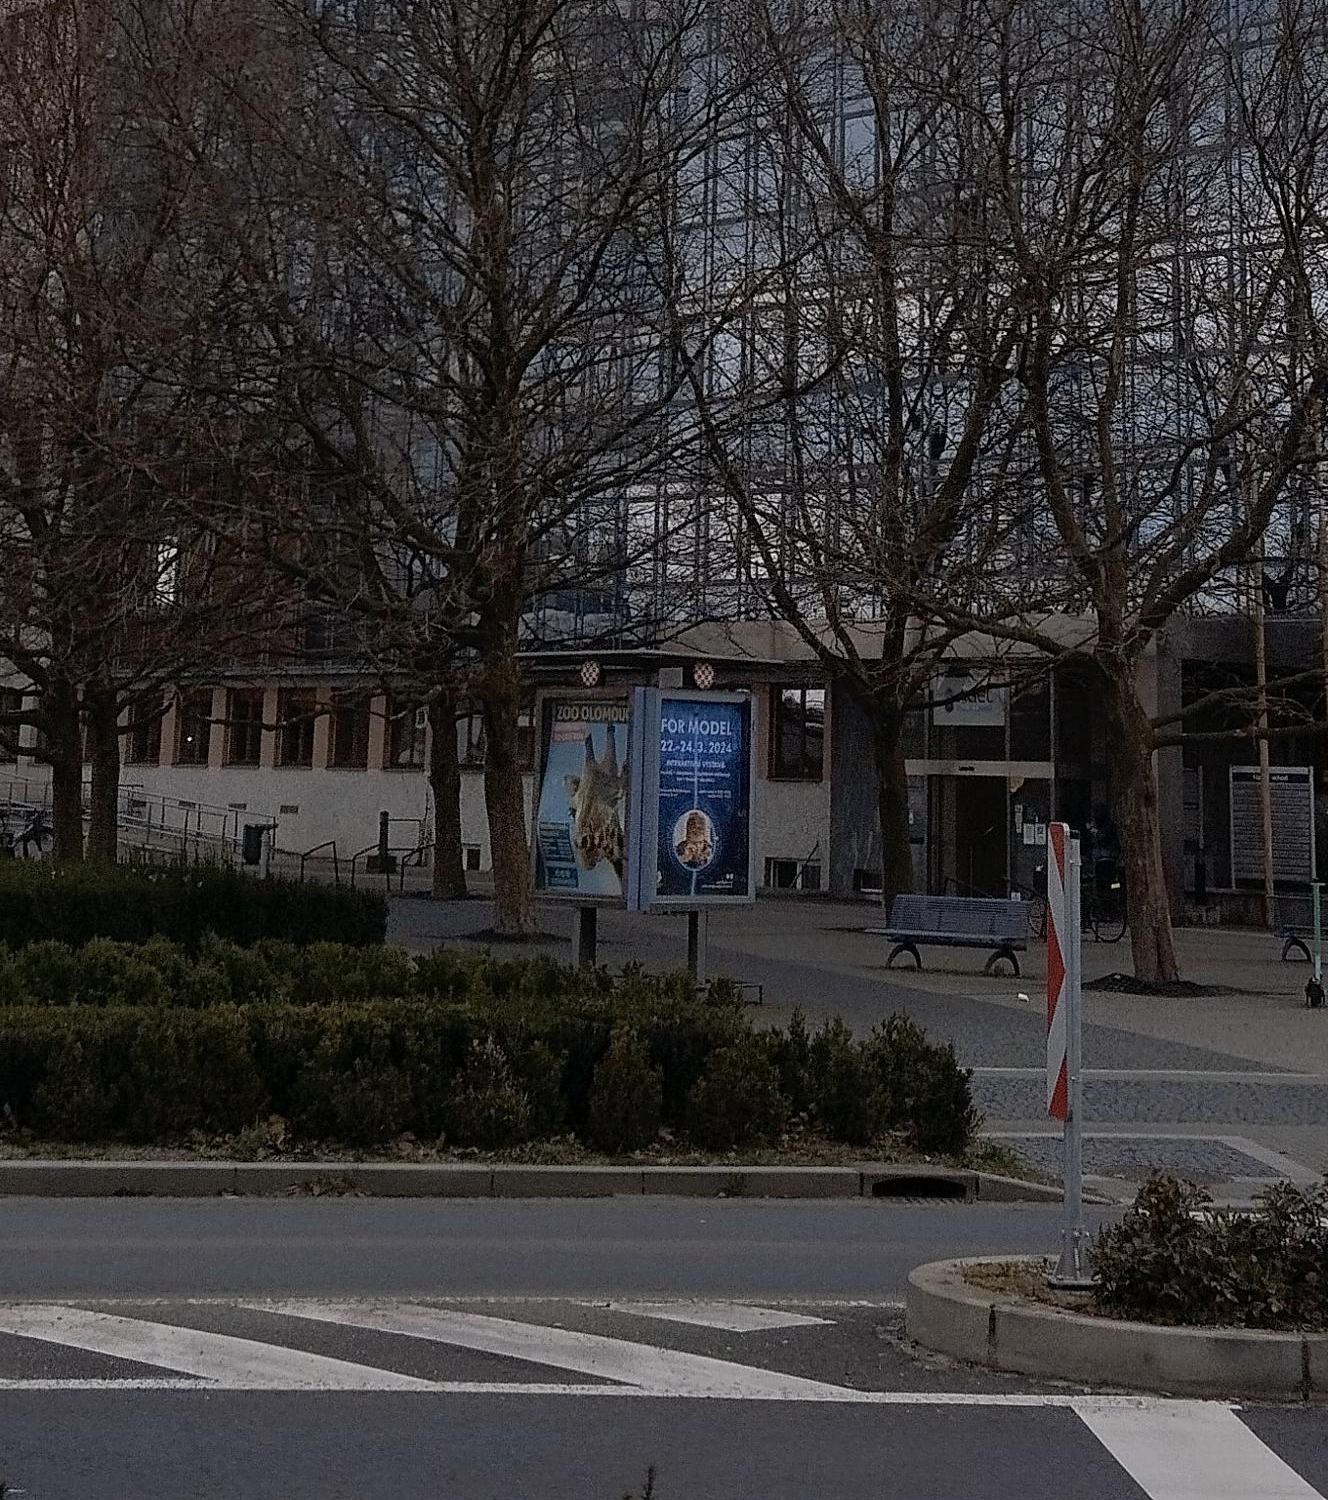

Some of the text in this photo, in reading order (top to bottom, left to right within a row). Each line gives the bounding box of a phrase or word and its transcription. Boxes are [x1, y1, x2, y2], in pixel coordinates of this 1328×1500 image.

[557, 705, 579, 721] ZOO
[661, 718, 732, 736] FOR MODEL
[709, 741, 732, 754] 2024
